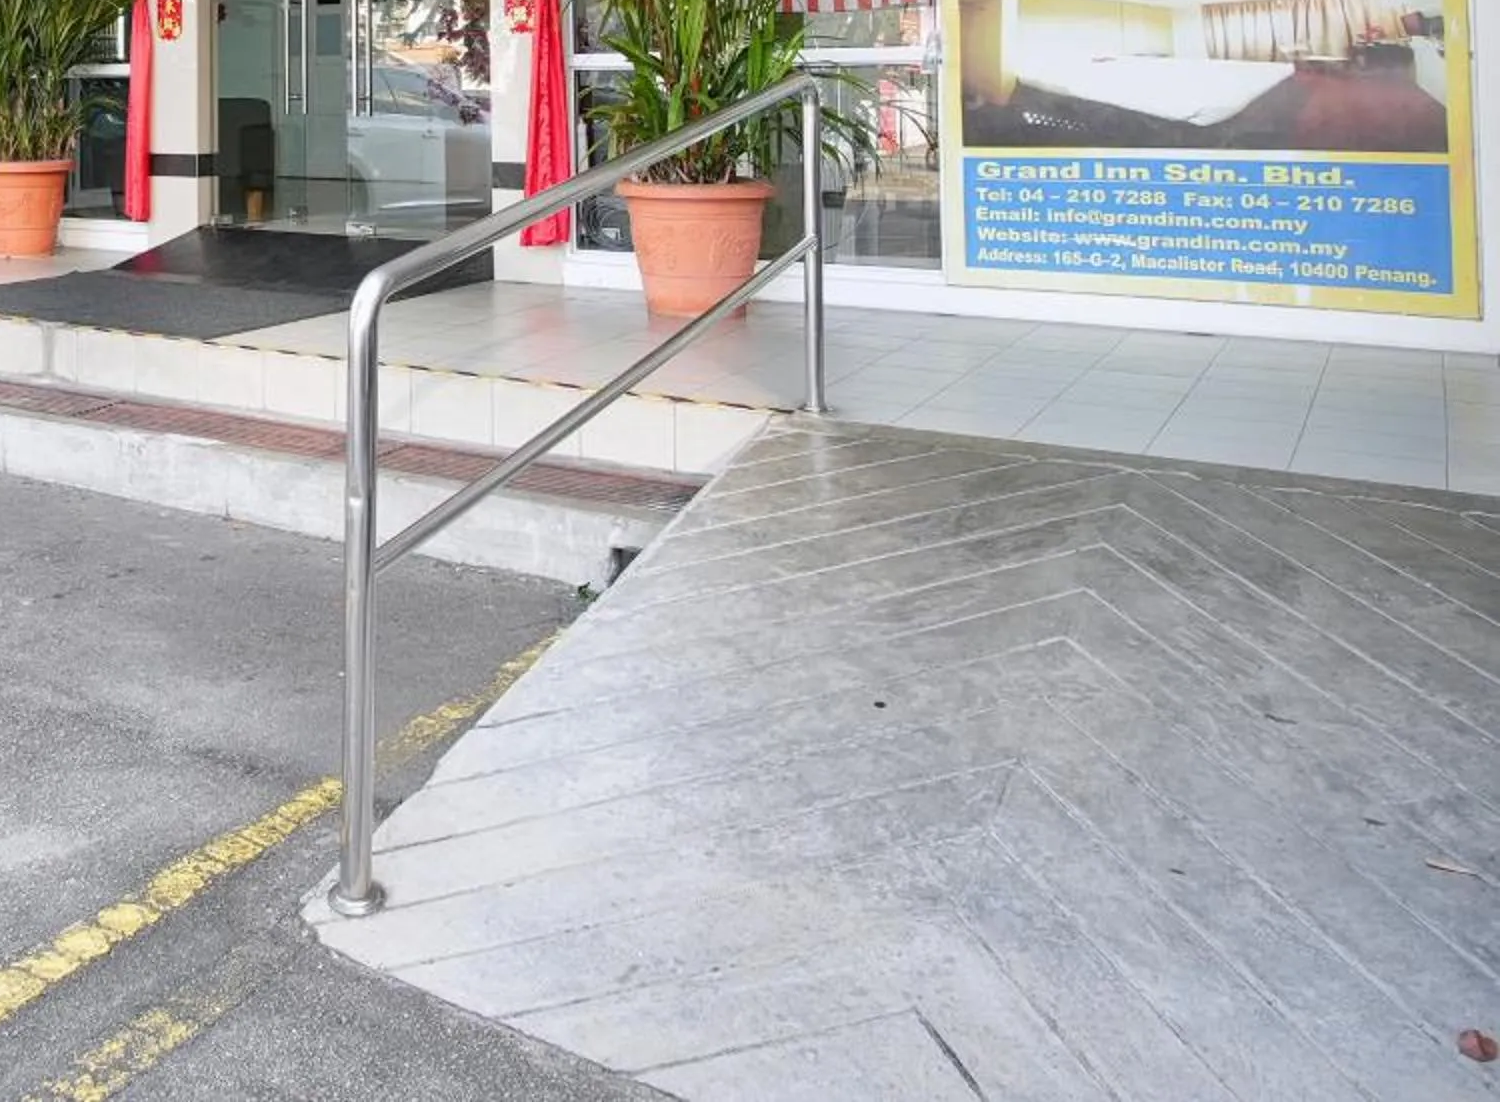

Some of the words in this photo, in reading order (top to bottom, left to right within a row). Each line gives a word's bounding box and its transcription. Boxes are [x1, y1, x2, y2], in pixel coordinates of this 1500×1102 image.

[977, 161, 1081, 180] Grand
[1094, 162, 1150, 180] Inn
[1164, 163, 1248, 184] Sdn.
[1264, 165, 1354, 187] Bhd.
[975, 187, 1012, 203] Tel:
[1019, 188, 1043, 203] 04
[1067, 189, 1105, 204] 210
[1184, 192, 1233, 208] Fax:
[1241, 193, 1271, 209] 04
[1297, 196, 1342, 212] 210
[1351, 198, 1416, 215] 7286
[976, 207, 1040, 223] Email:
[1047, 207, 1308, 235] info@grandinn.com.my
[977, 226, 1067, 244] Website:
[1073, 233, 1348, 259] www.grandinn.com.my
[978, 248, 1047, 264] Address:
[1231, 258, 1284, 279] Road,
[1290, 262, 1348, 279] 10400
[1355, 265, 1437, 289] Penang.
